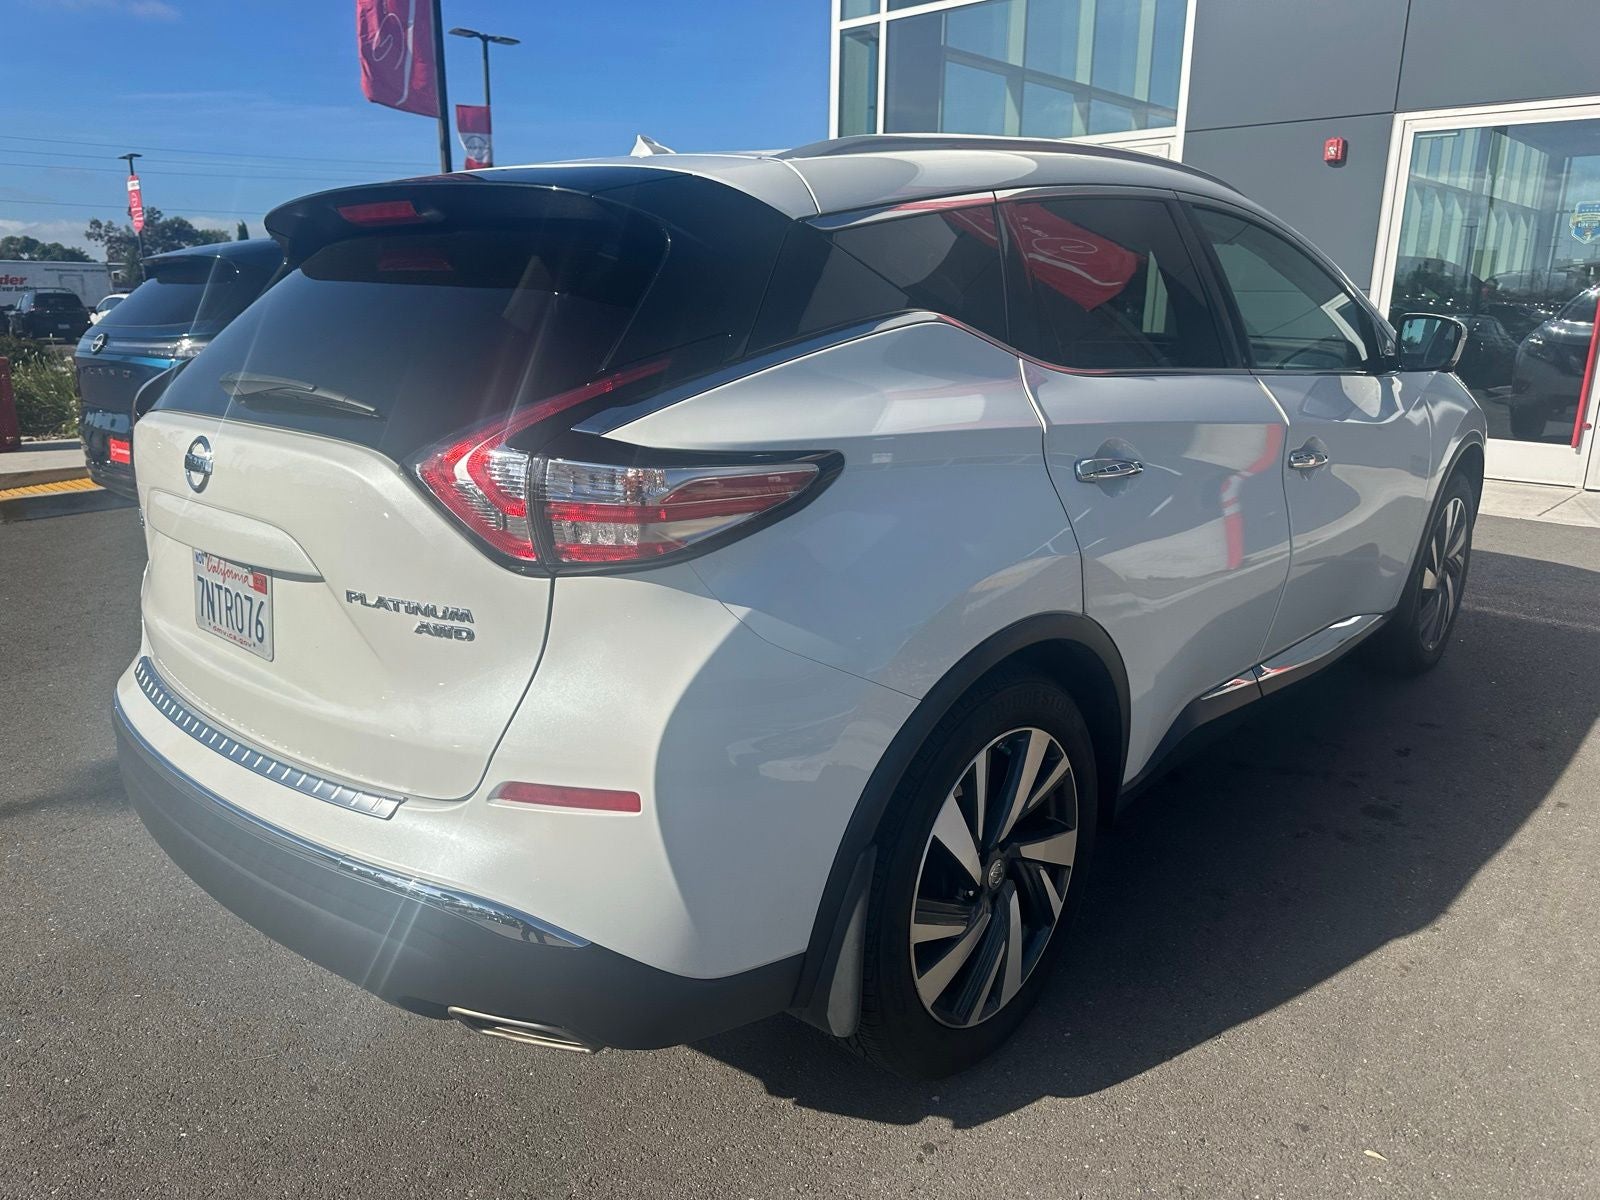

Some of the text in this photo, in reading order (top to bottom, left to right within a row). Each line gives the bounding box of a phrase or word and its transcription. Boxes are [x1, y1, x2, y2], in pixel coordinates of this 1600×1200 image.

[206, 554, 254, 588] California
[197, 576, 264, 643] 7NTR076
[345, 589, 475, 623] PLATINUM
[414, 620, 475, 642] AWD
